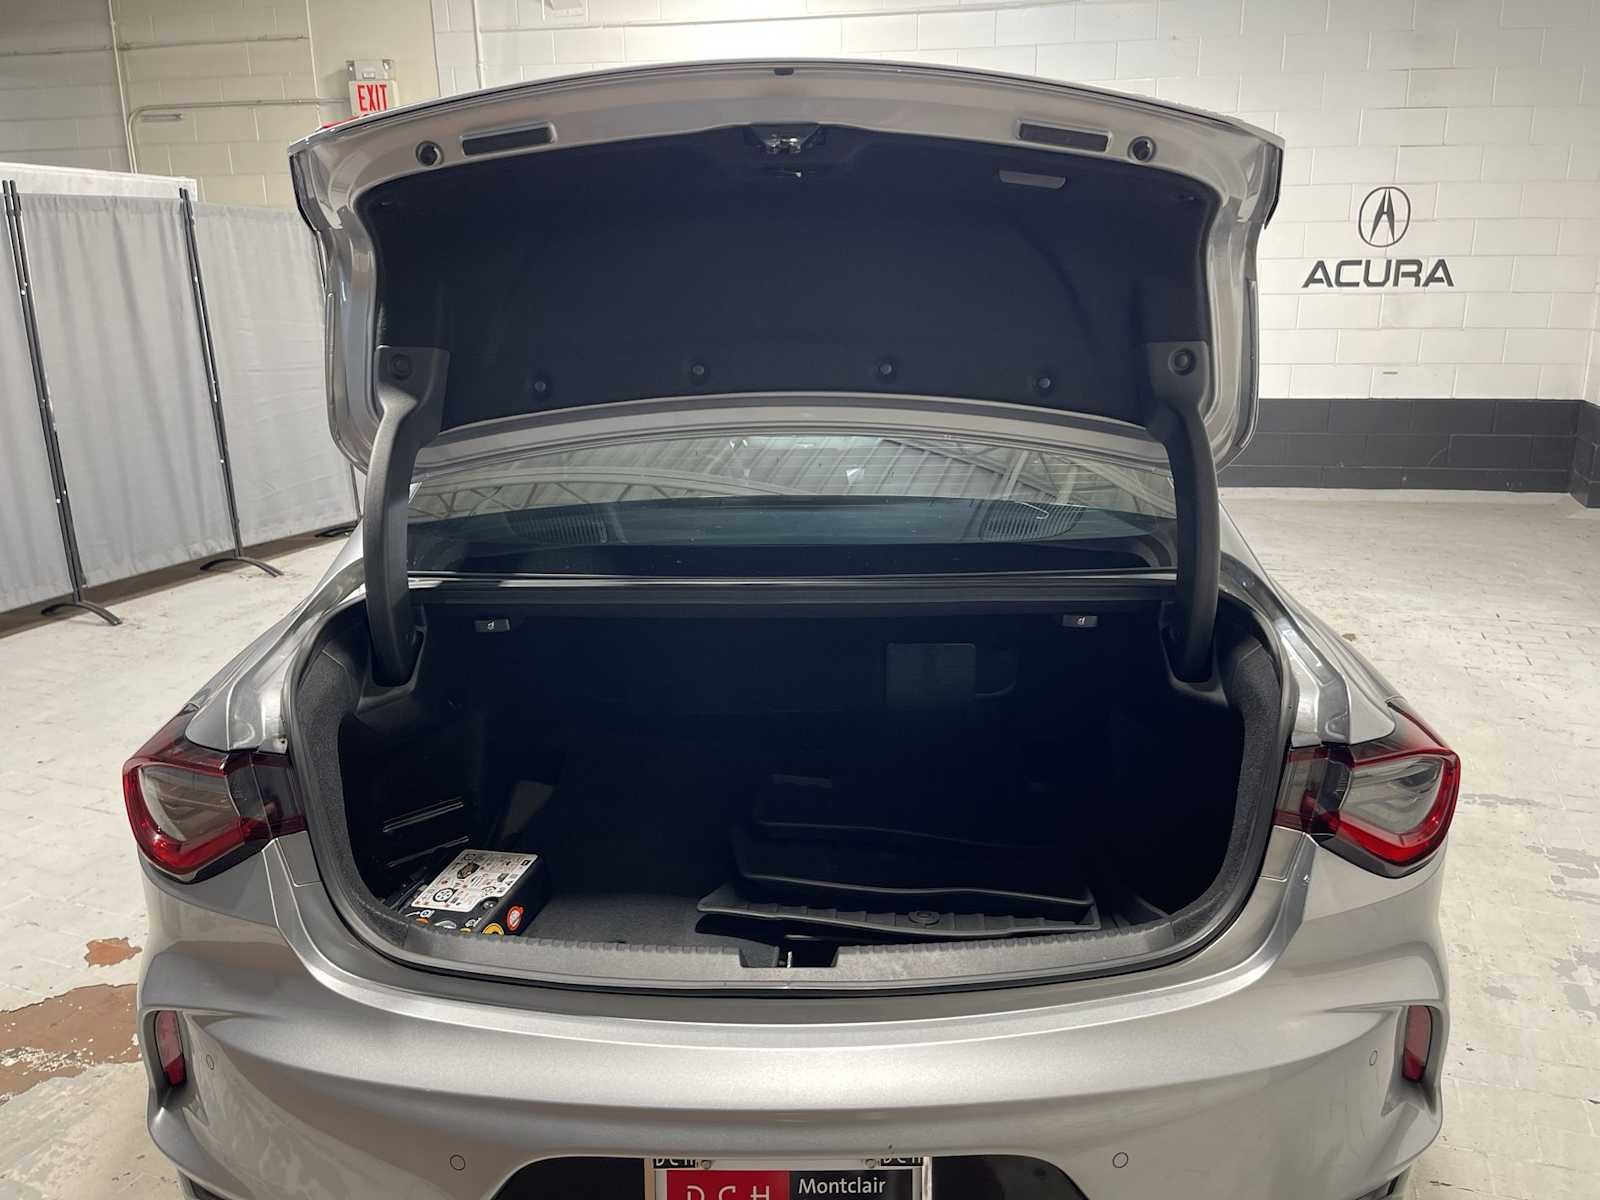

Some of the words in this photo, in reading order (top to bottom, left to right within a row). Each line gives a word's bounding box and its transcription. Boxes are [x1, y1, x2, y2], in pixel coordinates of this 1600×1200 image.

[356, 84, 388, 112] EXIT
[1301, 258, 1455, 289] ACURA
[687, 1185, 770, 1200] DCH
[798, 1177, 886, 1194] Montclair
